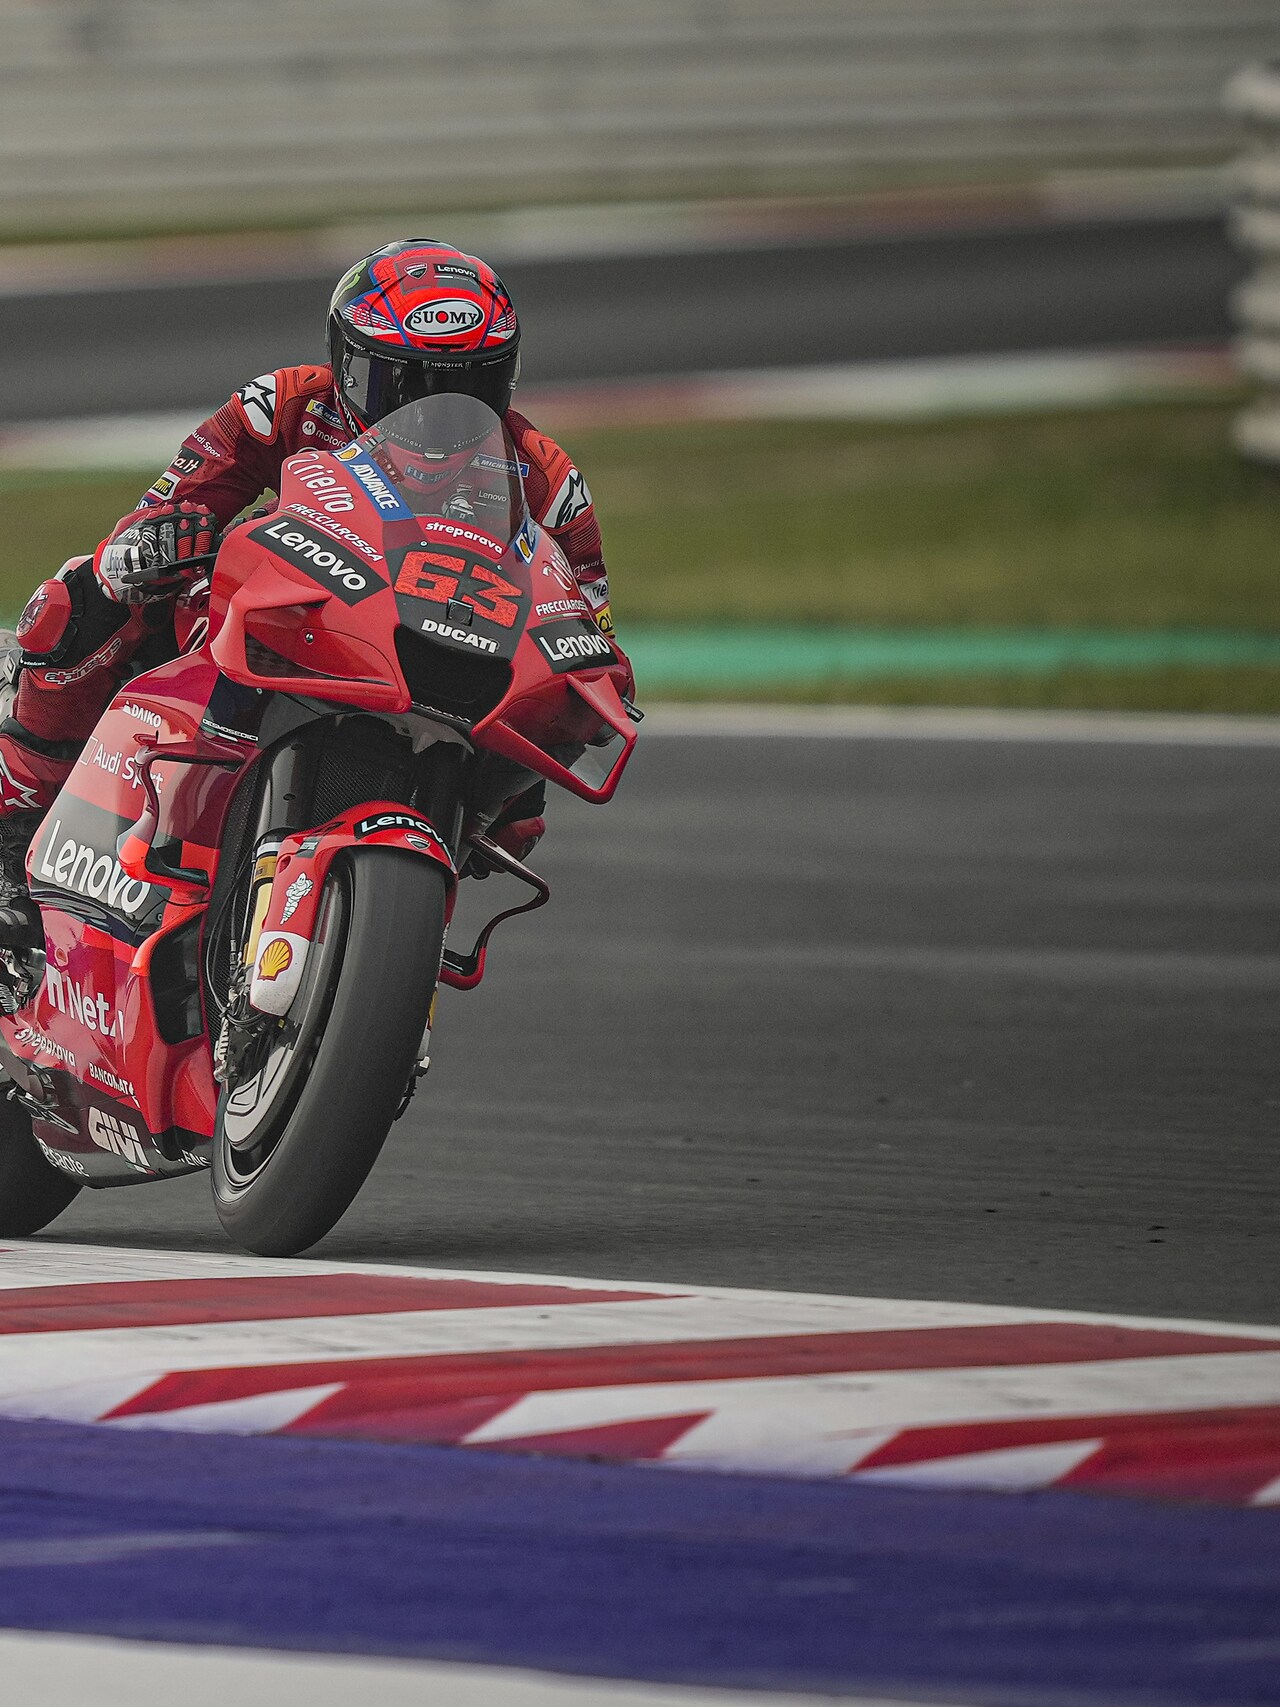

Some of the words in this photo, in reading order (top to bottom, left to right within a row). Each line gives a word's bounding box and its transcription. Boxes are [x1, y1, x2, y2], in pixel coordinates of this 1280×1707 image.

[437, 265, 476, 278] Lenovo
[413, 311, 477, 325] SUOMY
[192, 430, 206, 445] udi
[203, 441, 221, 458] Sport
[316, 430, 347, 448] motoro
[480, 459, 517, 473] MICHELIN
[348, 462, 400, 510] ADVANCE
[478, 490, 507, 502] Lenovo
[285, 503, 384, 562] FRECCIAROSSA
[425, 521, 504, 554] streparava
[264, 521, 367, 591] Lenovo
[393, 551, 523, 628] 63
[421, 619, 498, 654] DUCATI
[539, 634, 610, 662] Lenovo
[93, 743, 122, 774] Audi
[122, 758, 164, 794] Sprt
[361, 816, 452, 860] Lenov
[41, 819, 151, 913] Lenovo
[88, 1062, 129, 1095] BANCOMAT
[88, 1105, 150, 1167] GIVI
